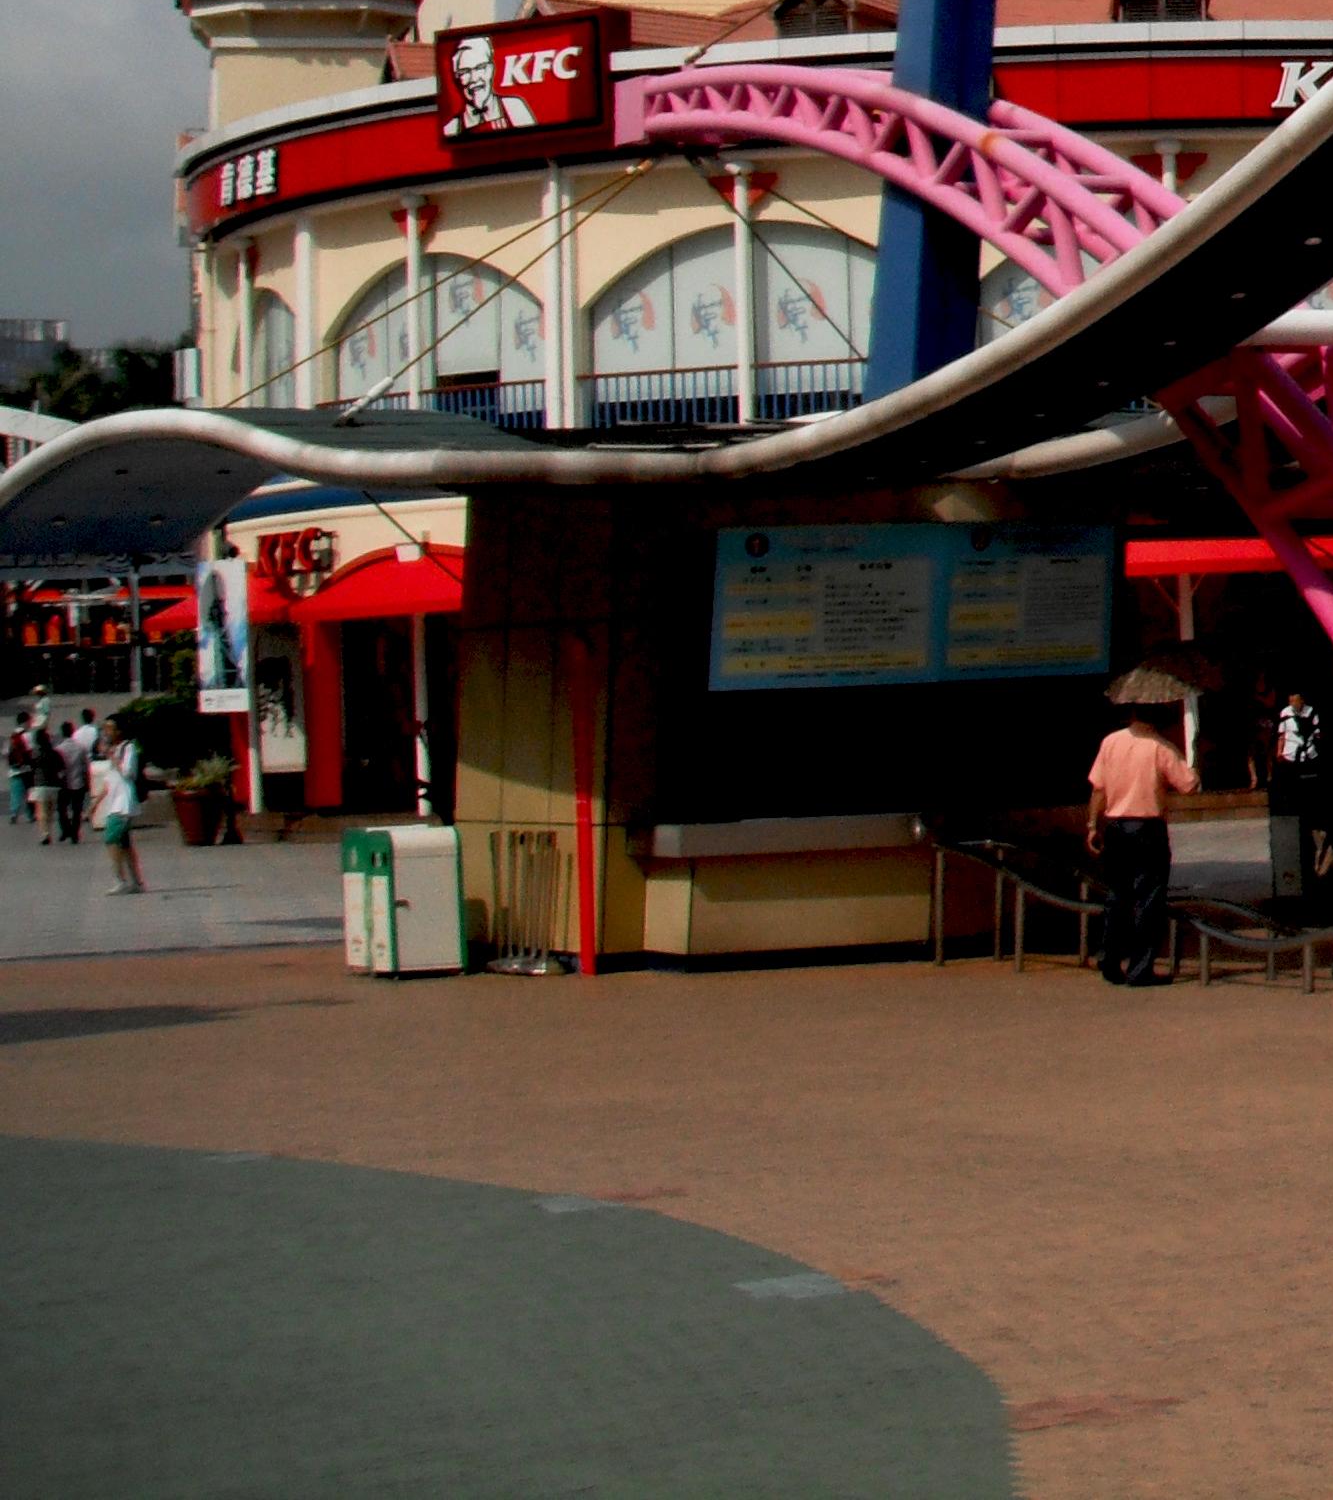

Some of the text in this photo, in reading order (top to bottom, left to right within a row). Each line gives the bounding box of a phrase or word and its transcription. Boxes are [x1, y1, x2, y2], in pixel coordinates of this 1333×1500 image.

[501, 45, 584, 88] KFC
[220, 148, 277, 206] 肯德基
